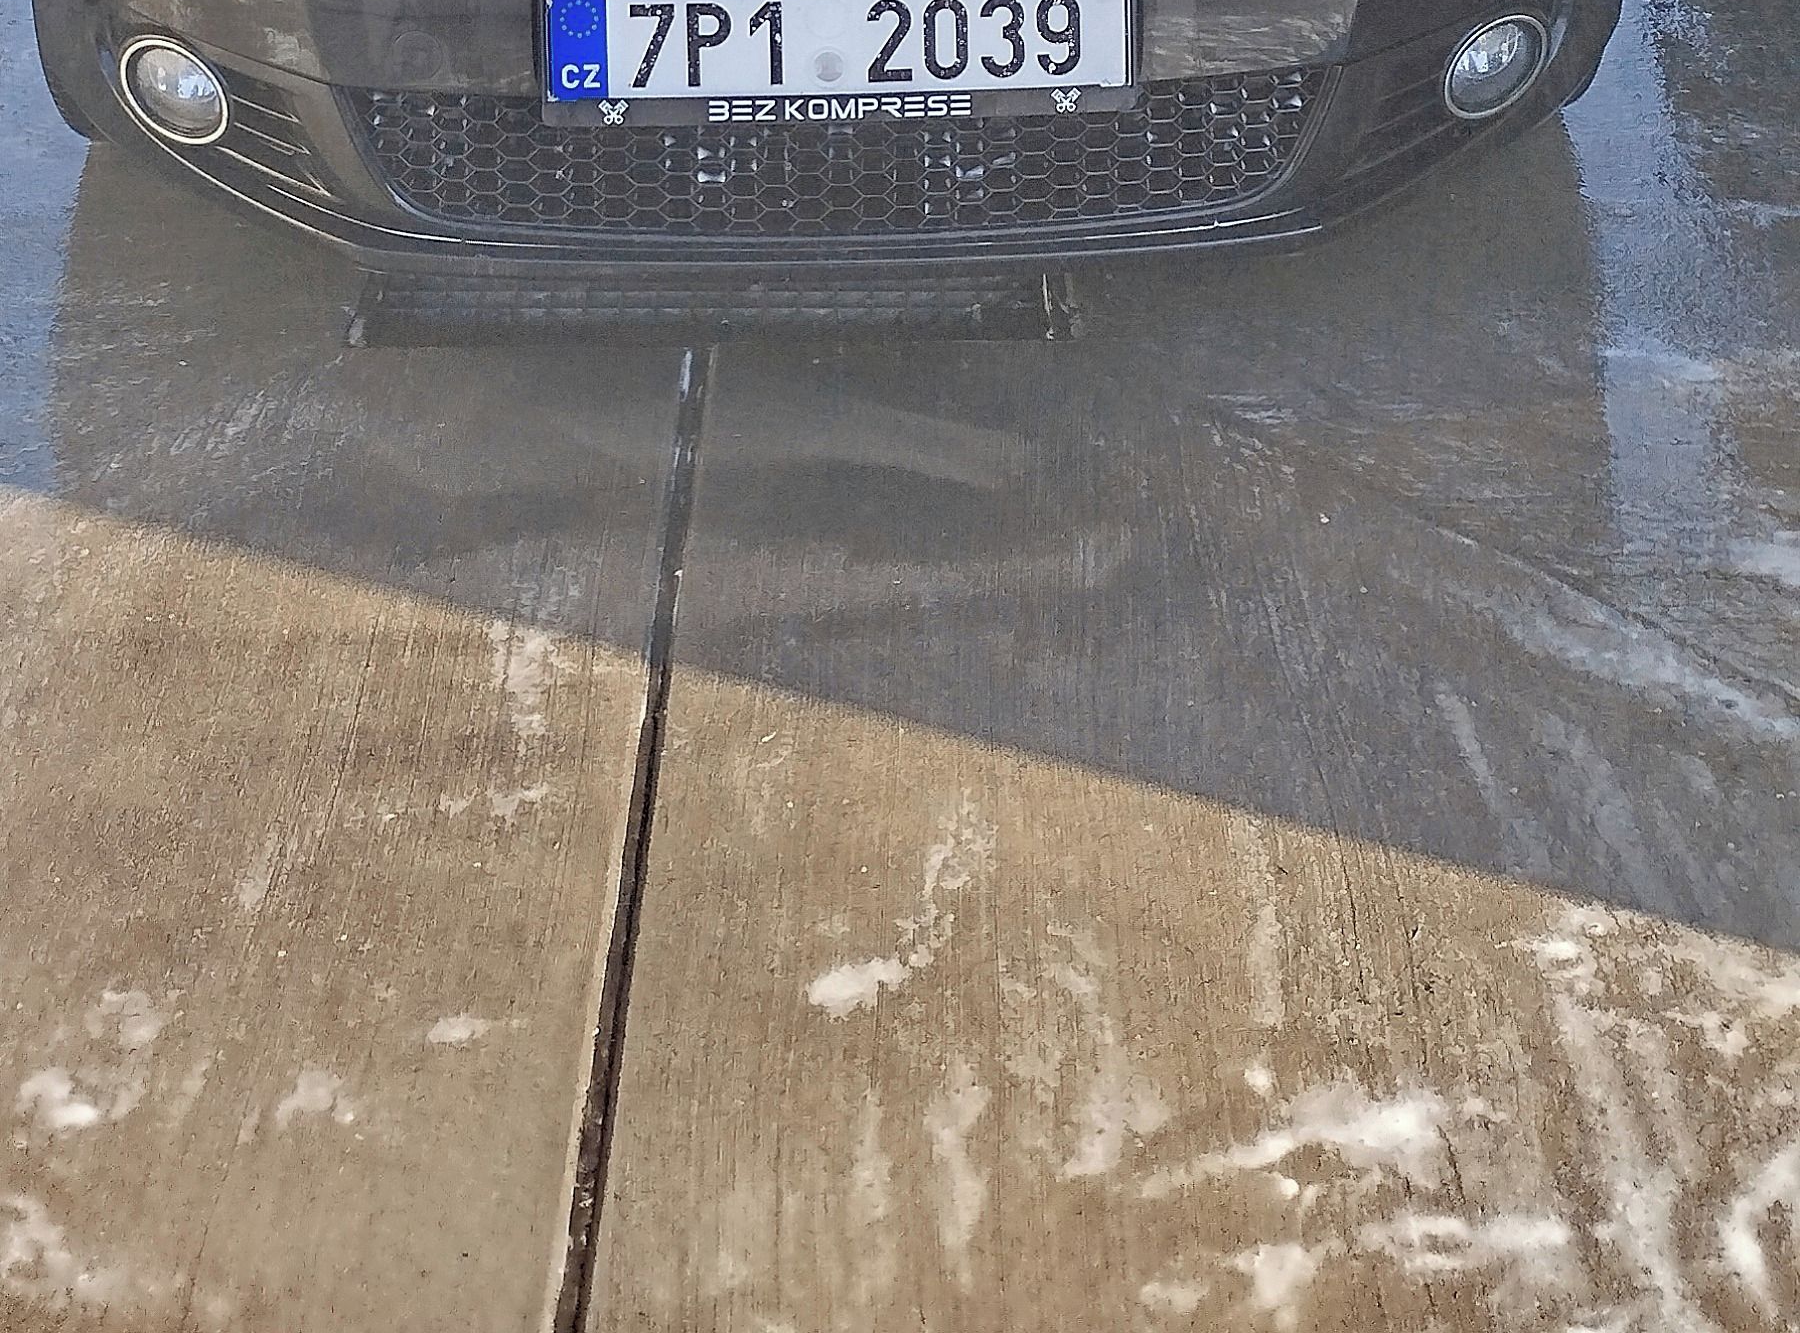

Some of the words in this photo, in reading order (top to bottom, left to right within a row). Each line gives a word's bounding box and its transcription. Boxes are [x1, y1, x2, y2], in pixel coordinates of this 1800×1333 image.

[628, 0, 784, 89] 7P1
[560, 63, 601, 89] CZ
[708, 99, 776, 121] BEZ
[784, 94, 972, 121] KOMPRESE
